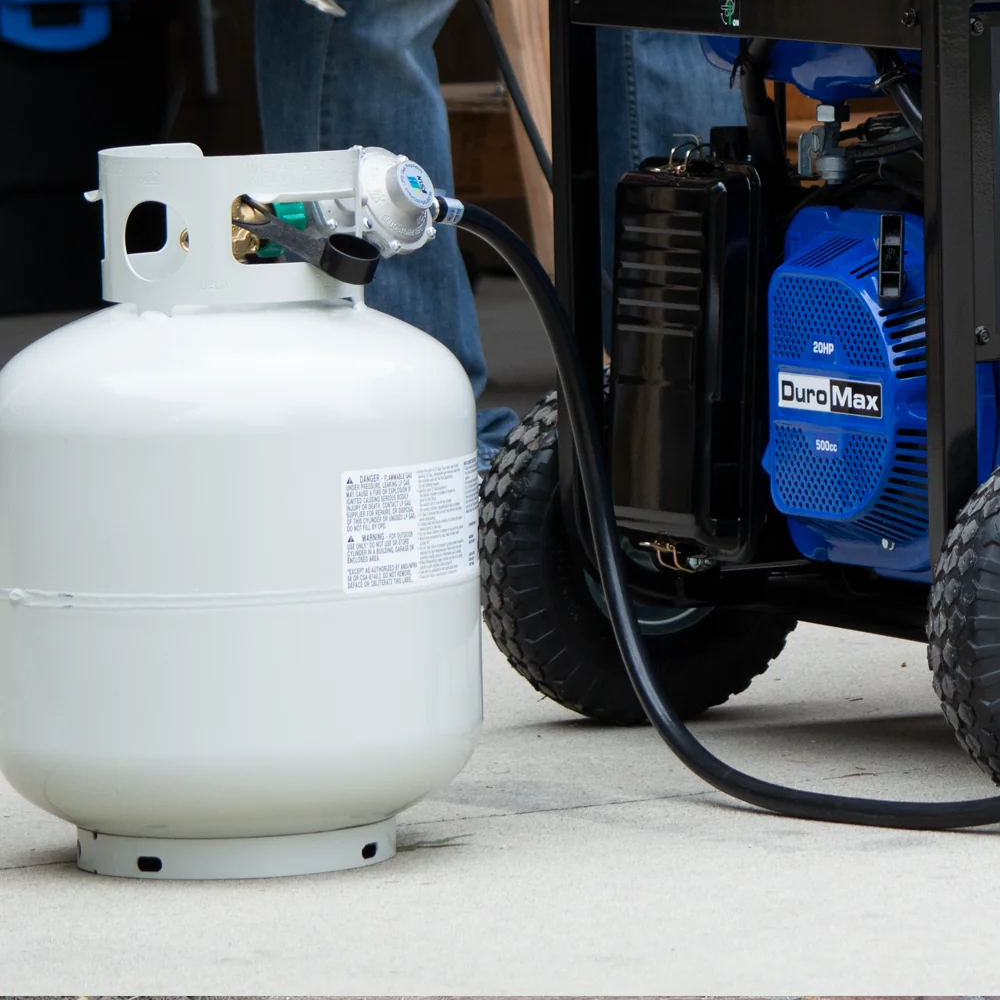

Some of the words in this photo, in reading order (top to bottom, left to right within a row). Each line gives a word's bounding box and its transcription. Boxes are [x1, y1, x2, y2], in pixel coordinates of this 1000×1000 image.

[813, 341, 834, 355] 20HP
[782, 380, 828, 405] Duro
[832, 385, 879, 411] Max
[816, 440, 838, 452] 500cc
[360, 474, 380, 483] DANGER
[362, 533, 384, 541] WARNING
